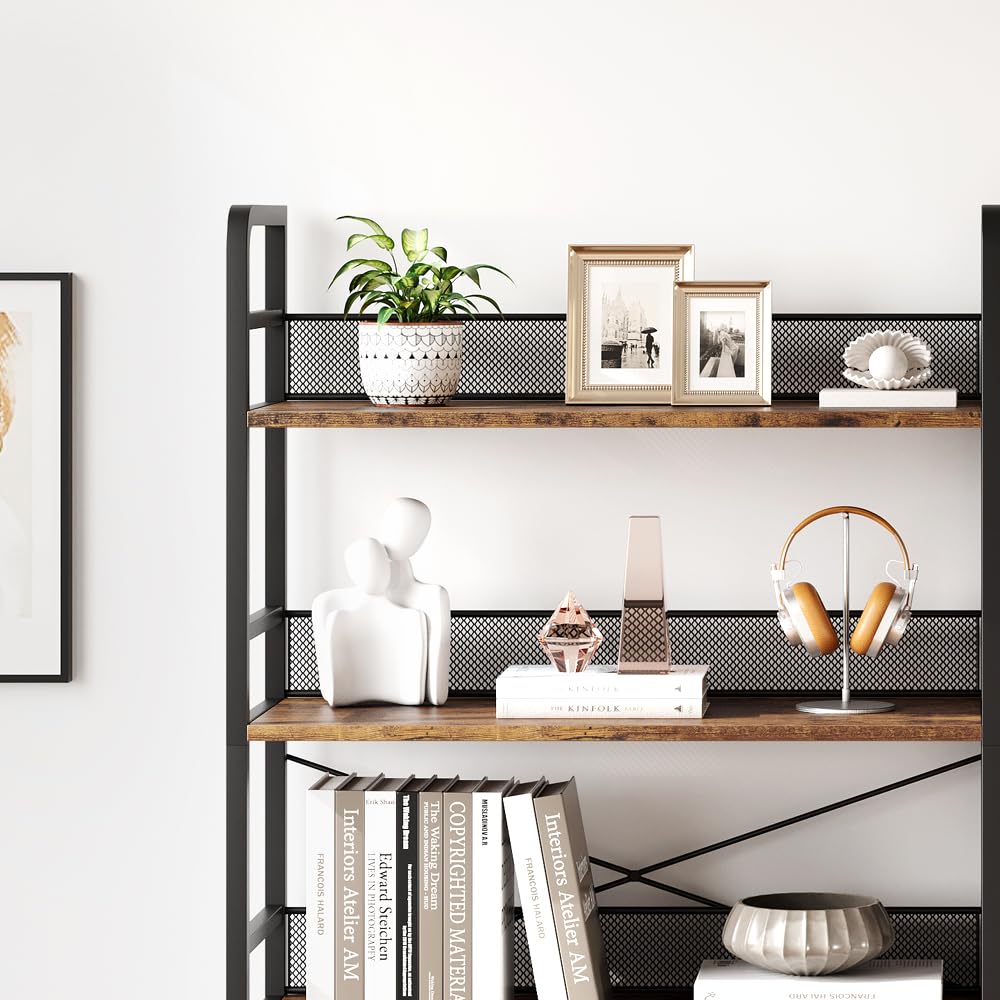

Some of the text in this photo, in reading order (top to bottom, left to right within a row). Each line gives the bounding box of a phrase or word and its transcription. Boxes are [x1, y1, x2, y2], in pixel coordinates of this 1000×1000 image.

[343, 808, 360, 981] Interiors Atelier AM
[367, 853, 376, 879] LIVES
[367, 880, 376, 891] IN
[380, 854, 392, 960] Edward Steichen
[429, 801, 440, 911] The Waking Dream
[450, 802, 465, 923] COPYRIGHTED
[524, 857, 545, 939] FRANCOIS HALARD
[544, 812, 590, 984] Interiors Atelier AM
